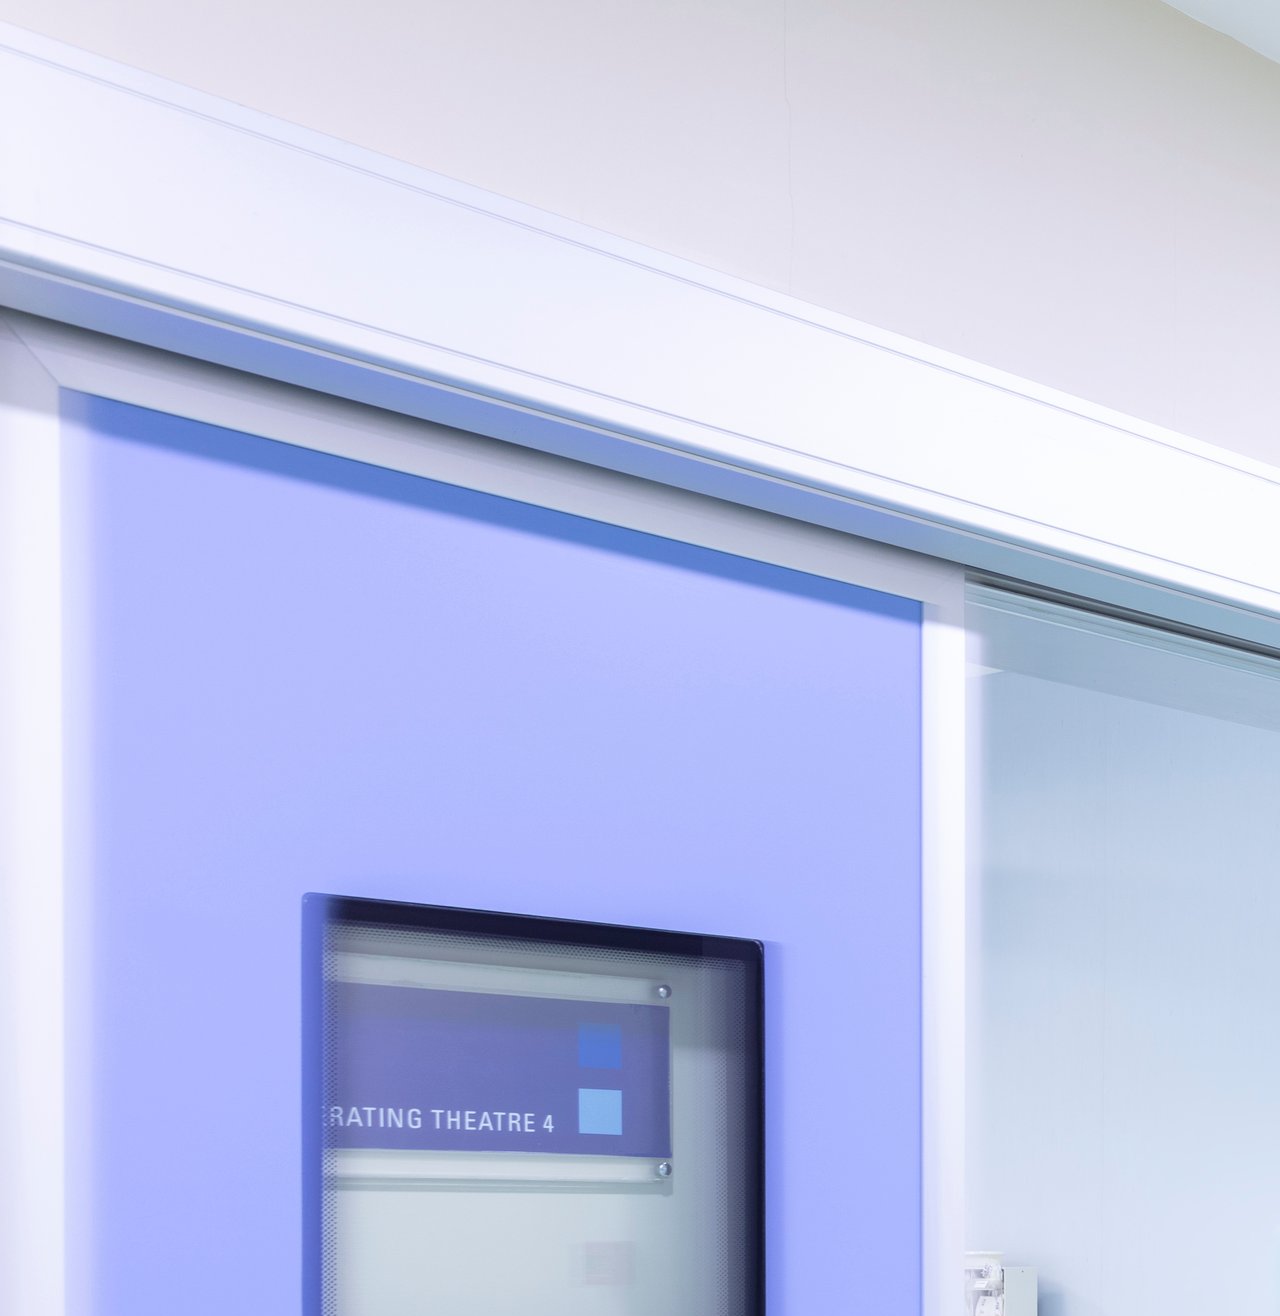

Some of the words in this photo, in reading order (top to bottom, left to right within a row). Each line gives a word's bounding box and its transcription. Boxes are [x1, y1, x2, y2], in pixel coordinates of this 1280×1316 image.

[322, 1106, 422, 1129] RATING
[431, 1109, 536, 1133] THEATRE
[542, 1114, 555, 1133] 4
